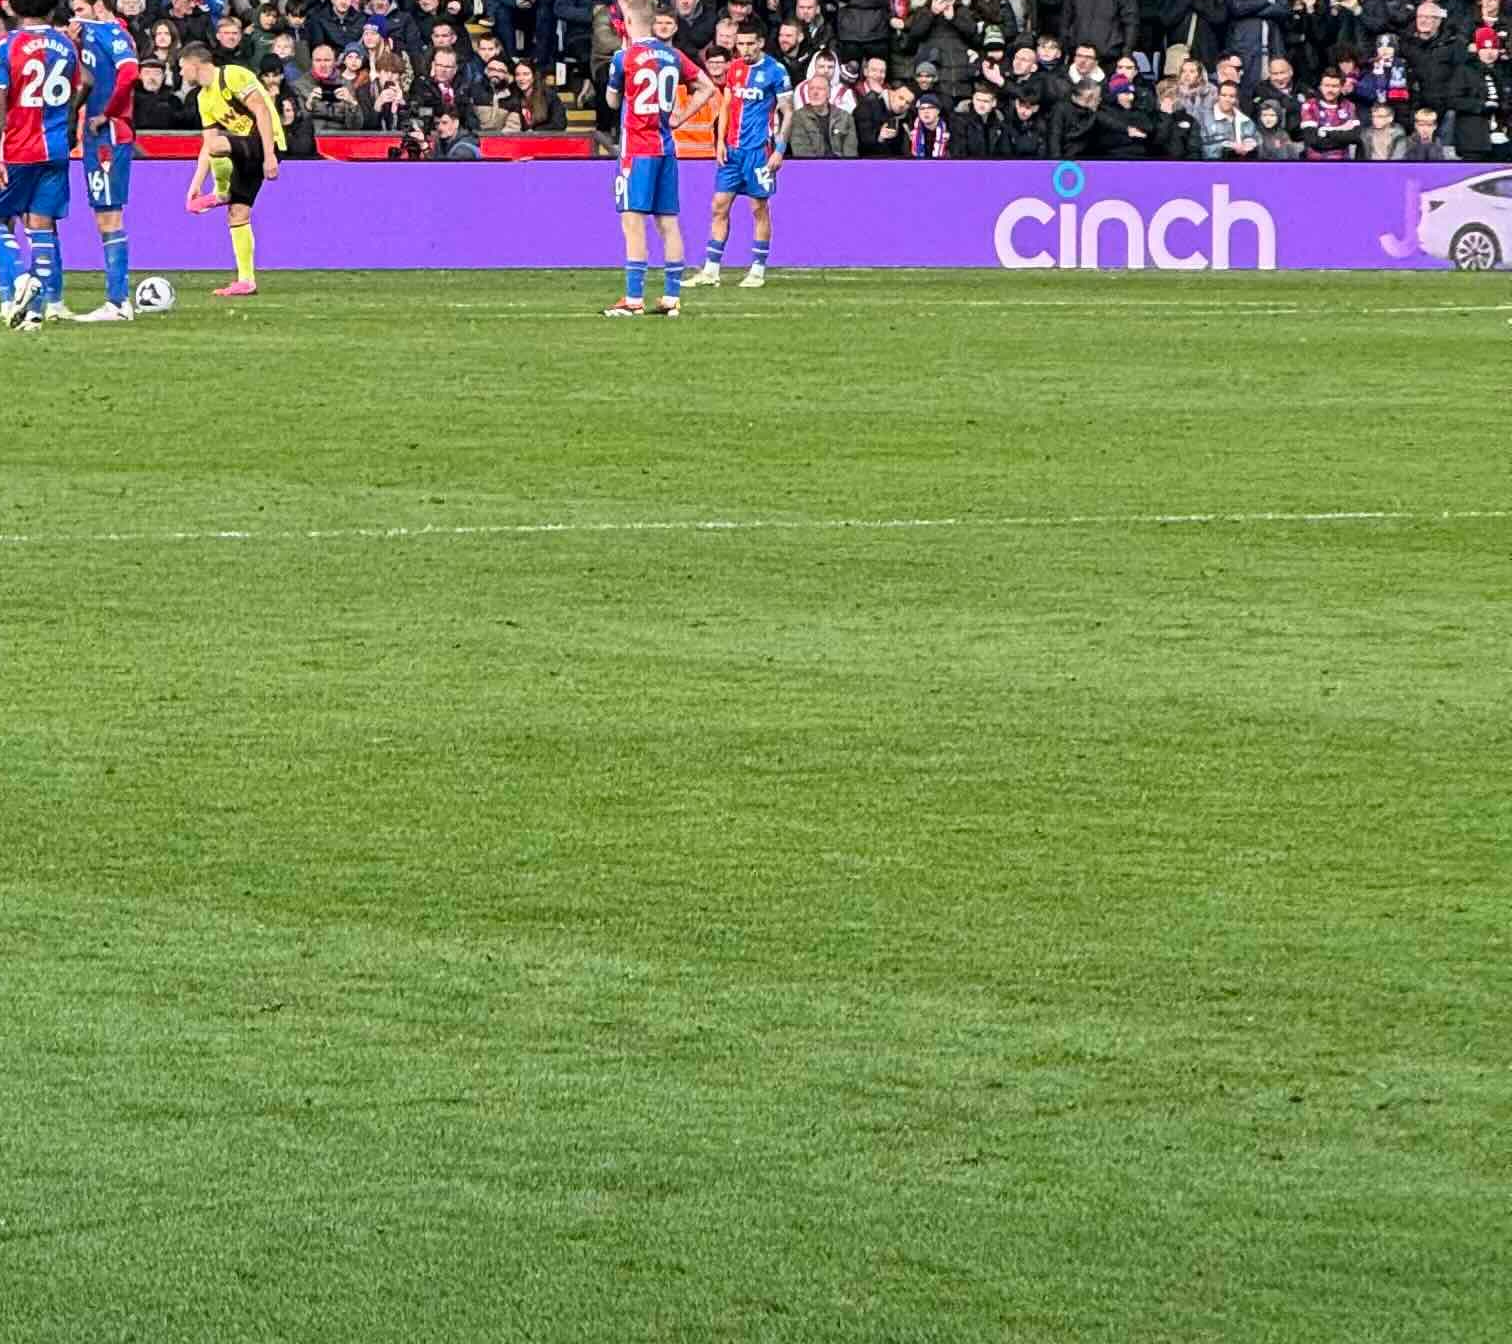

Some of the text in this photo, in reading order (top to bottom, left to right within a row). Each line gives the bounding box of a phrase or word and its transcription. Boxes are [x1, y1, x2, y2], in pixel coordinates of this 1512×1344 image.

[20, 58, 72, 107] 26
[633, 65, 680, 115] 20
[994, 161, 1276, 272] cinch
